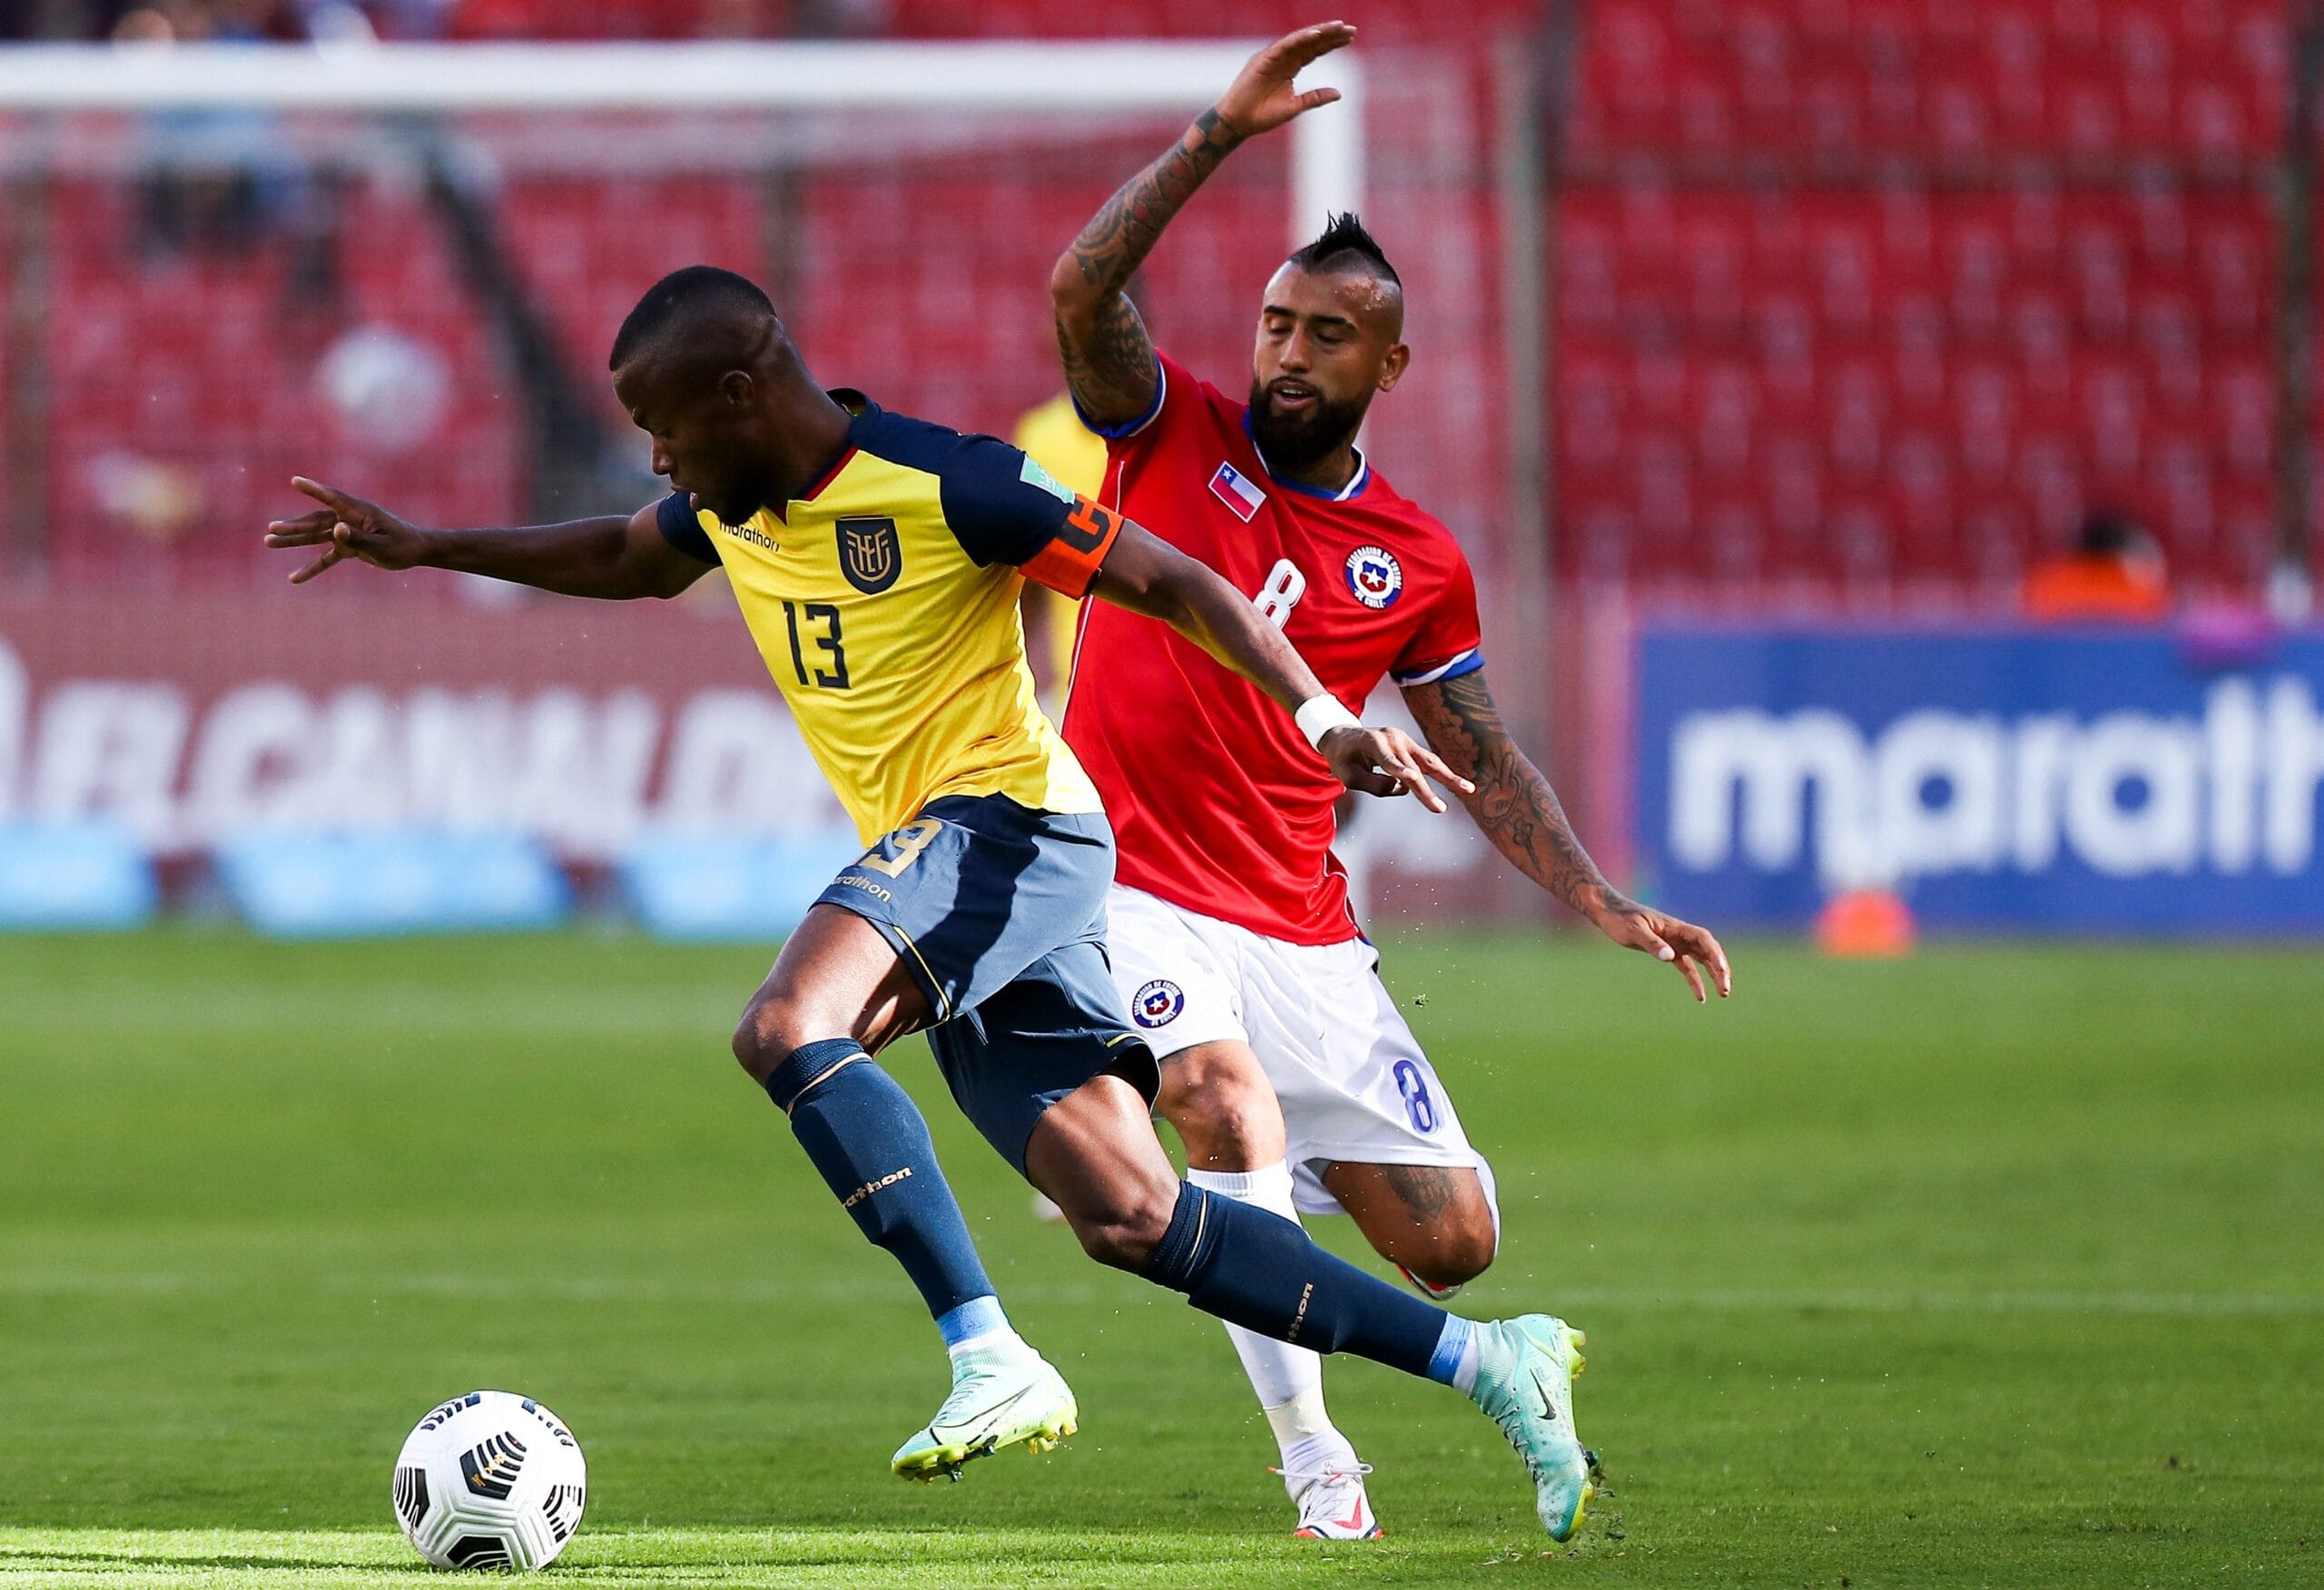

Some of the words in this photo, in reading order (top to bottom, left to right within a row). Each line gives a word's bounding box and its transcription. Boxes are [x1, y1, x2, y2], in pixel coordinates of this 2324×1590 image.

[1253, 558, 1306, 630] 8
[783, 601, 851, 689] 13
[1393, 1059, 1438, 1134] 8
